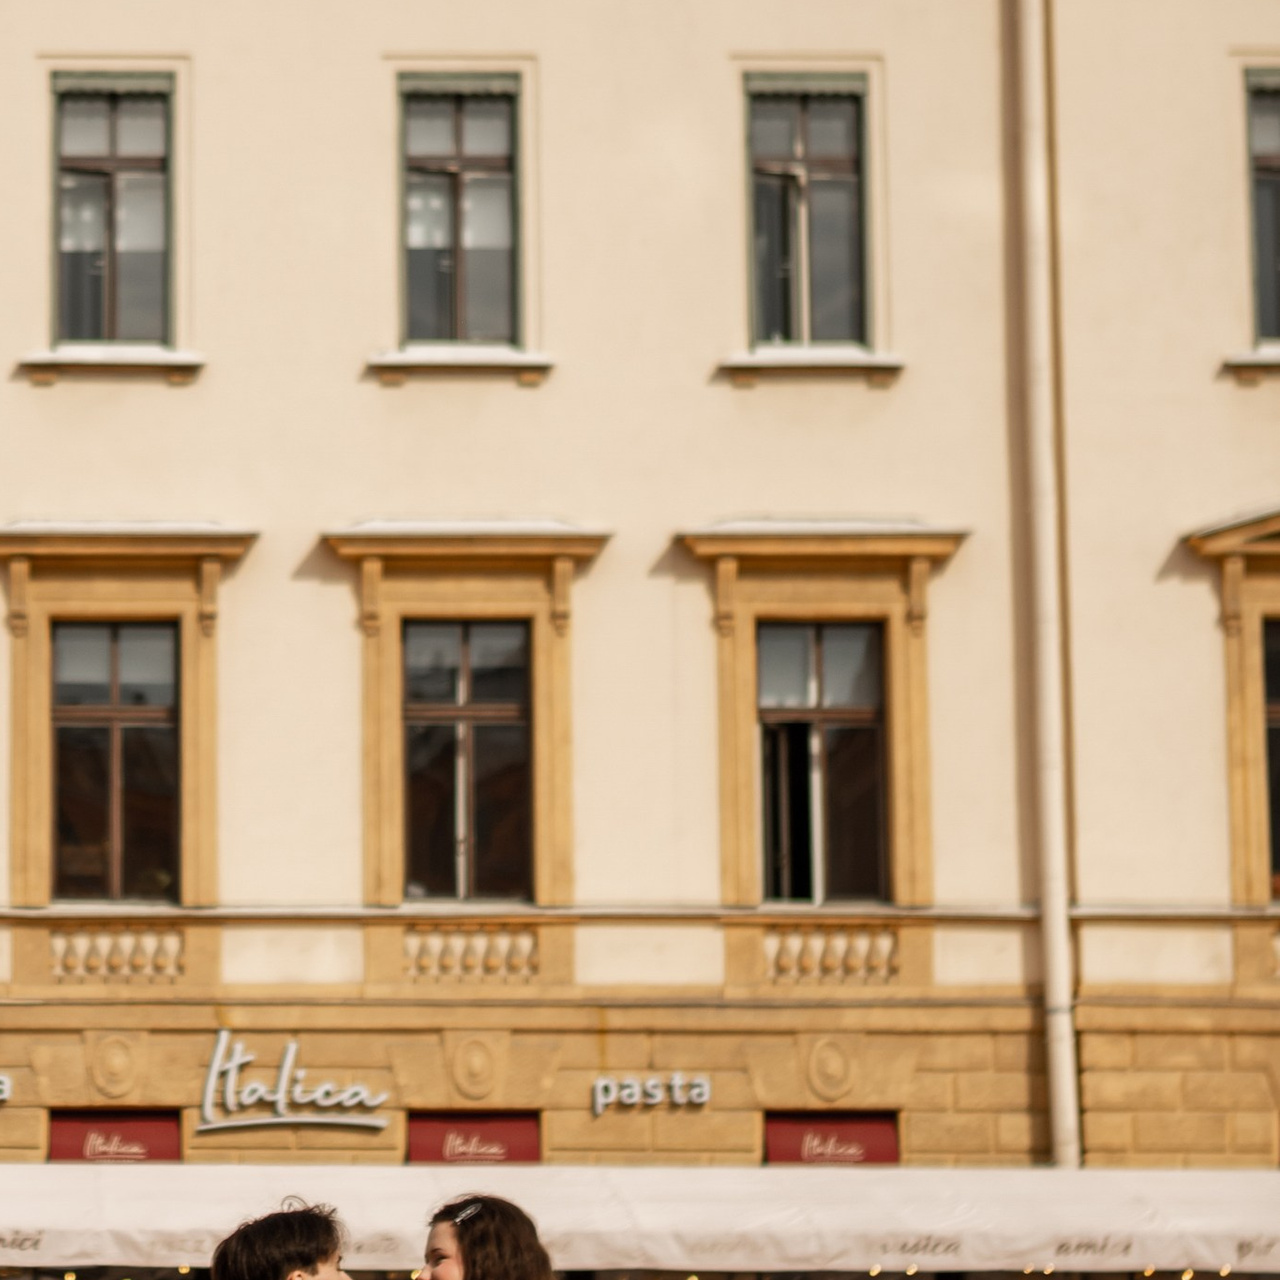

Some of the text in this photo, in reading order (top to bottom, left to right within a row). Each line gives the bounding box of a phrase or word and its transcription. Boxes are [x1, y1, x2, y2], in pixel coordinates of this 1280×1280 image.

[200, 1028, 391, 1120] Italica
[593, 1072, 712, 1114] pasta
[1055, 1235, 1132, 1256] amii
